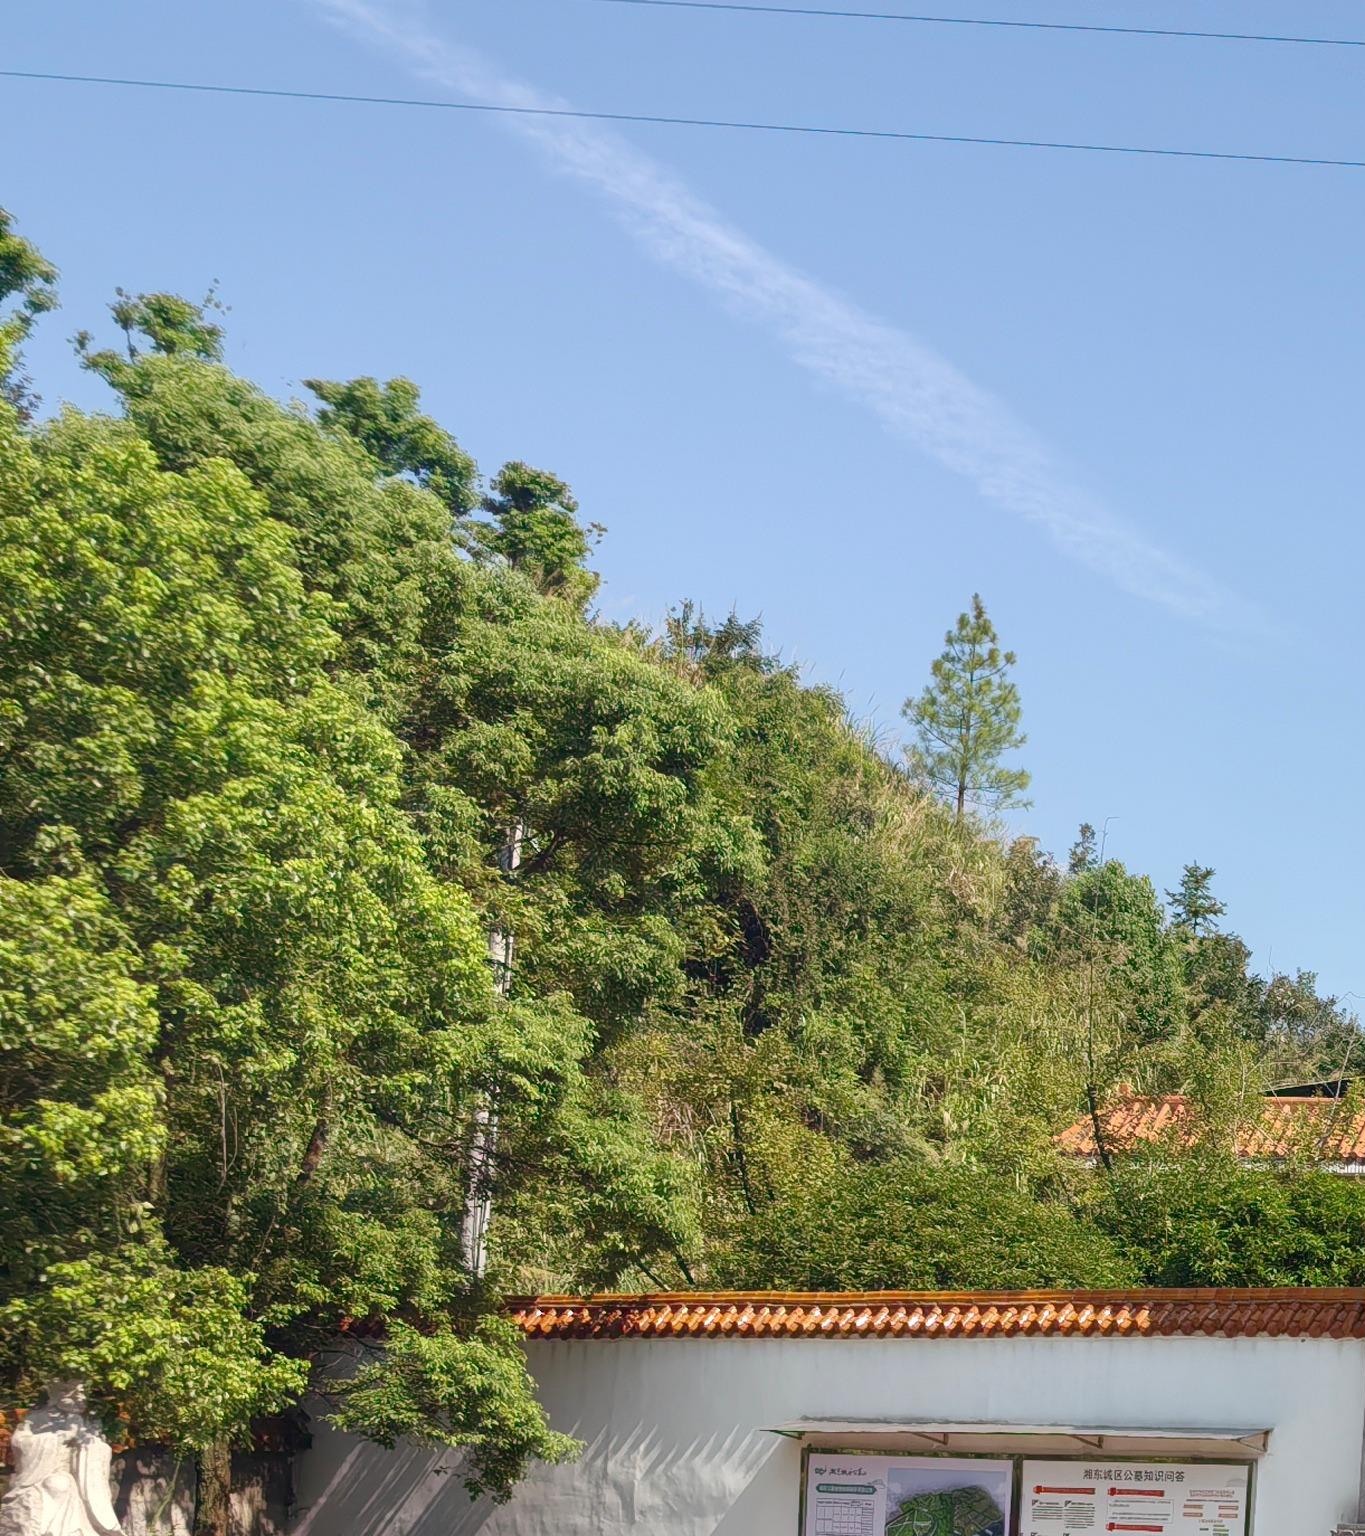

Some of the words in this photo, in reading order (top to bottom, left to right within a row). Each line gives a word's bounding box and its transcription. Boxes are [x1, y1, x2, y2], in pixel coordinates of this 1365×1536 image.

[1083, 1469, 1185, 1482] 湘东城区公墓知识问答
